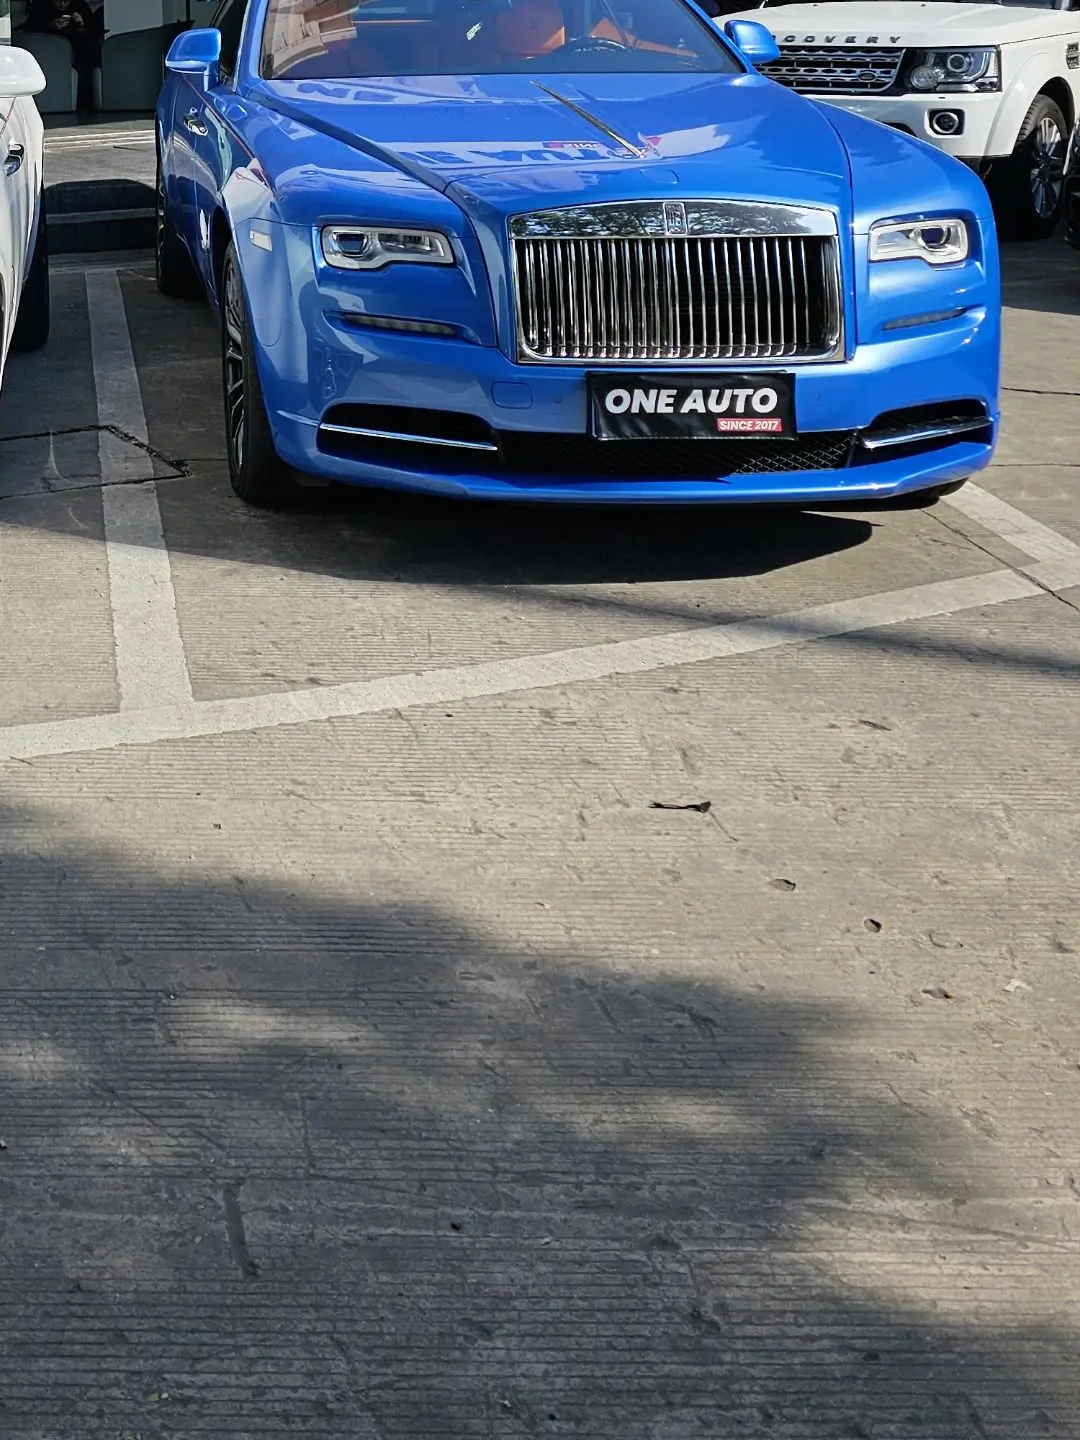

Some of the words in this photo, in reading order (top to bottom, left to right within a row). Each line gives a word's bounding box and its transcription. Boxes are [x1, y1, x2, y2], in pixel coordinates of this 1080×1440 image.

[772, 34, 902, 44] COVERY
[605, 388, 678, 414] ONE
[680, 387, 778, 414] AUTO
[719, 420, 753, 431] SINCE
[754, 420, 779, 431] 2017
